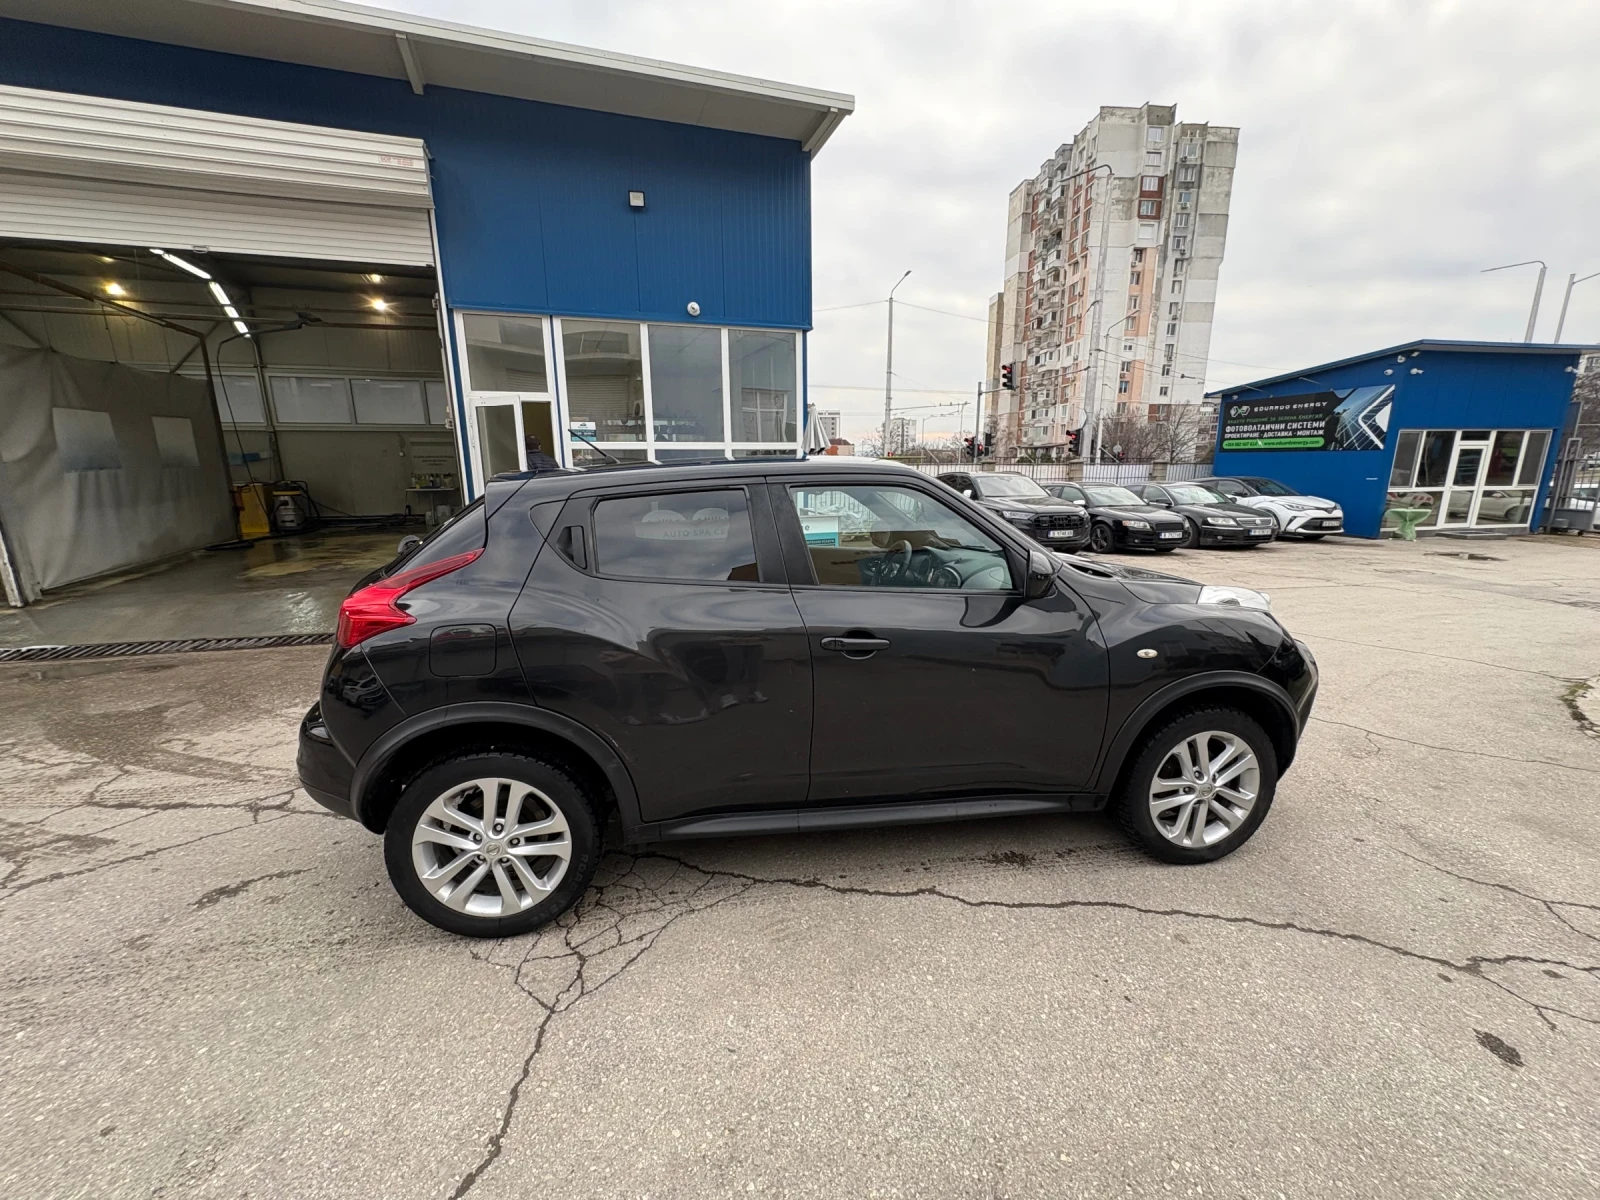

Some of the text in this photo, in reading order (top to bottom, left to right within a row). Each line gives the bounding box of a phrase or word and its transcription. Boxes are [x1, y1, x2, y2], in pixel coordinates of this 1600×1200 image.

[1254, 401, 1328, 412] EDUARDO ENERGY
[1225, 420, 1326, 433] ФОТОВОЛТАИЧНИ СИСТЕМИ
[1263, 430, 1293, 438] ДОСТАВКА
[663, 529, 690, 538] AUTO
[692, 528, 711, 537] SPA
